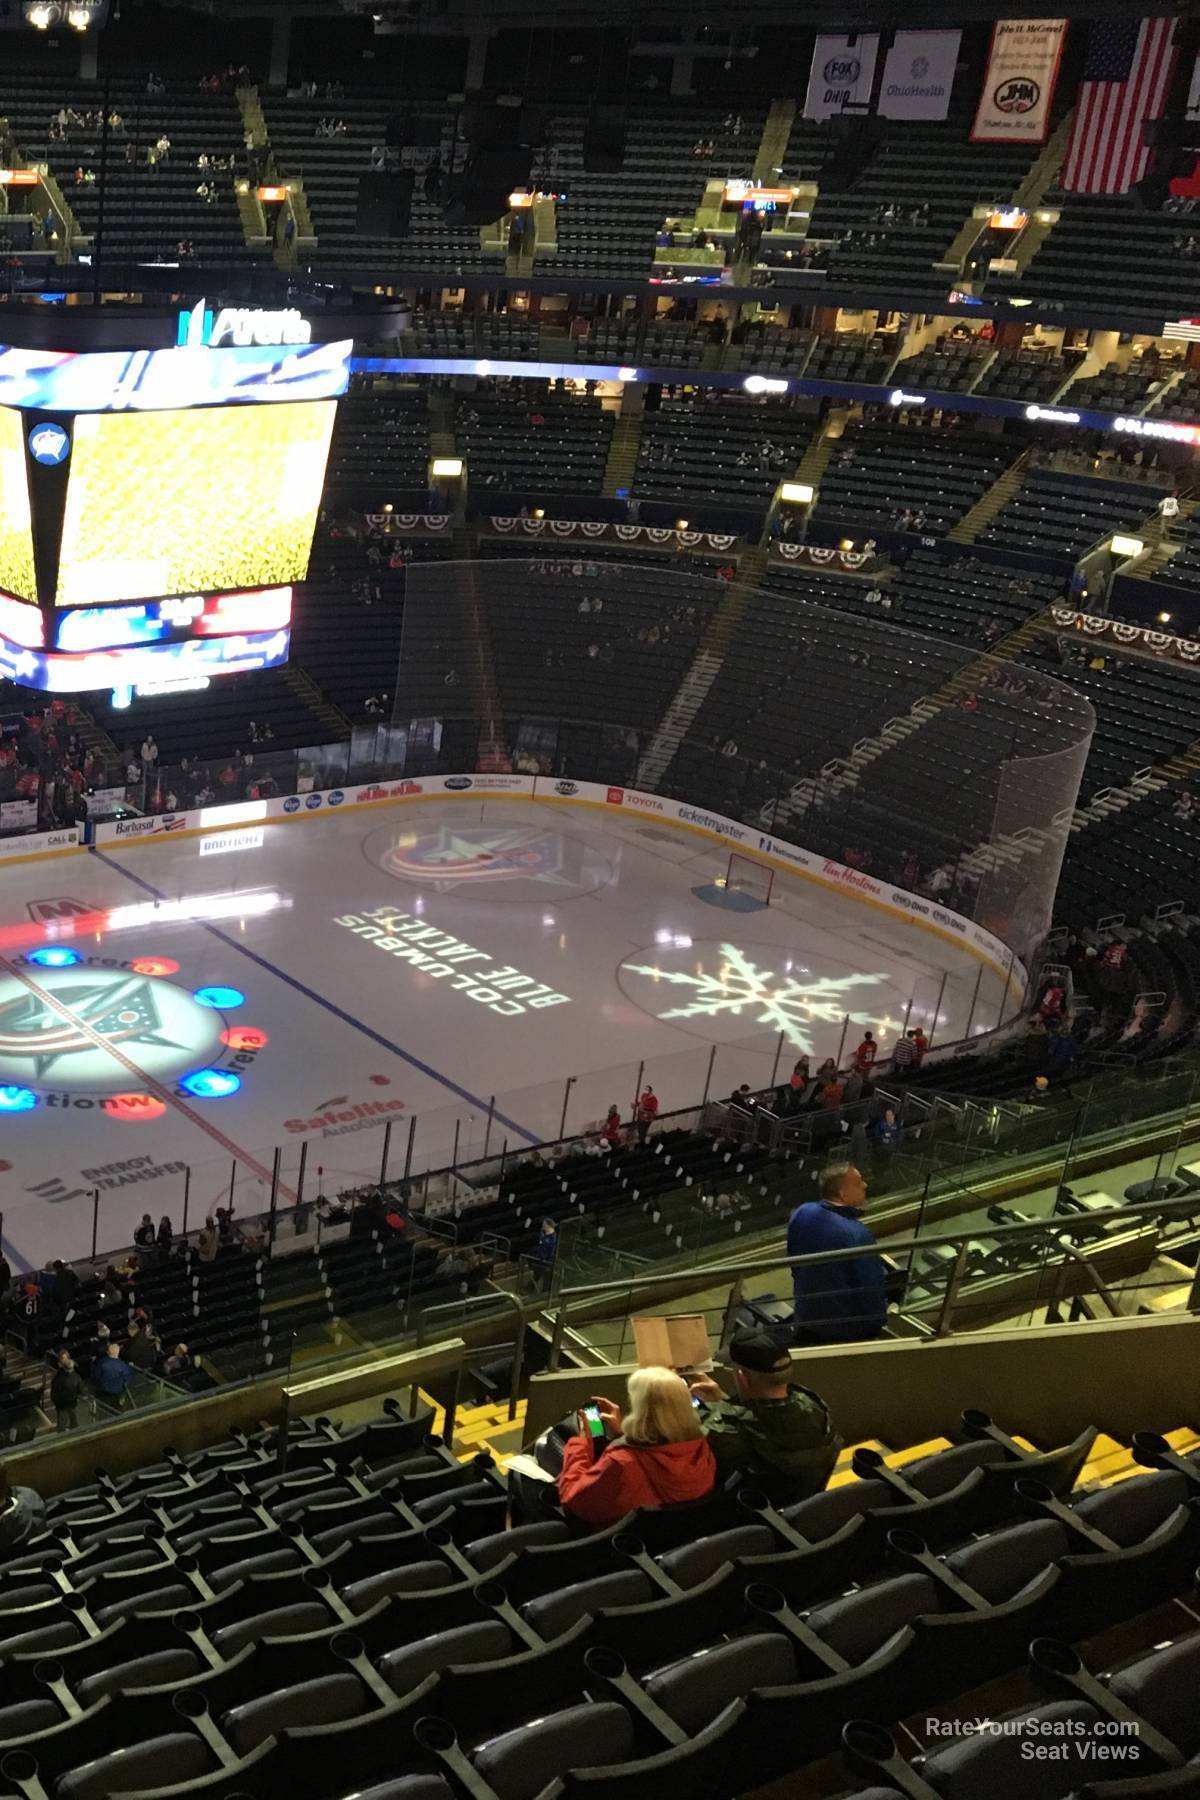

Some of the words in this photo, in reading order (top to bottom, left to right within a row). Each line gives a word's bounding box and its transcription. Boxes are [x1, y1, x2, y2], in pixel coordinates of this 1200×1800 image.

[831, 62, 852, 75] FOX
[886, 84, 945, 97] OhioHealth
[626, 794, 664, 811] TOYOTA
[115, 818, 155, 835] Barbasol
[678, 806, 745, 841] ticketmaster
[47, 835, 66, 844] CALL
[841, 869, 882, 896] Hortons
[361, 906, 493, 963] JACKETS
[333, 914, 528, 1016] COLUMBUS
[473, 965, 573, 1009] BLUE
[283, 1099, 405, 1134] Safelite
[322, 1113, 405, 1139] AutoGlass
[81, 1155, 154, 1181] ENERGY
[97, 1161, 188, 1192] TRANSFER
[25, 1300, 38, 1316] 61
